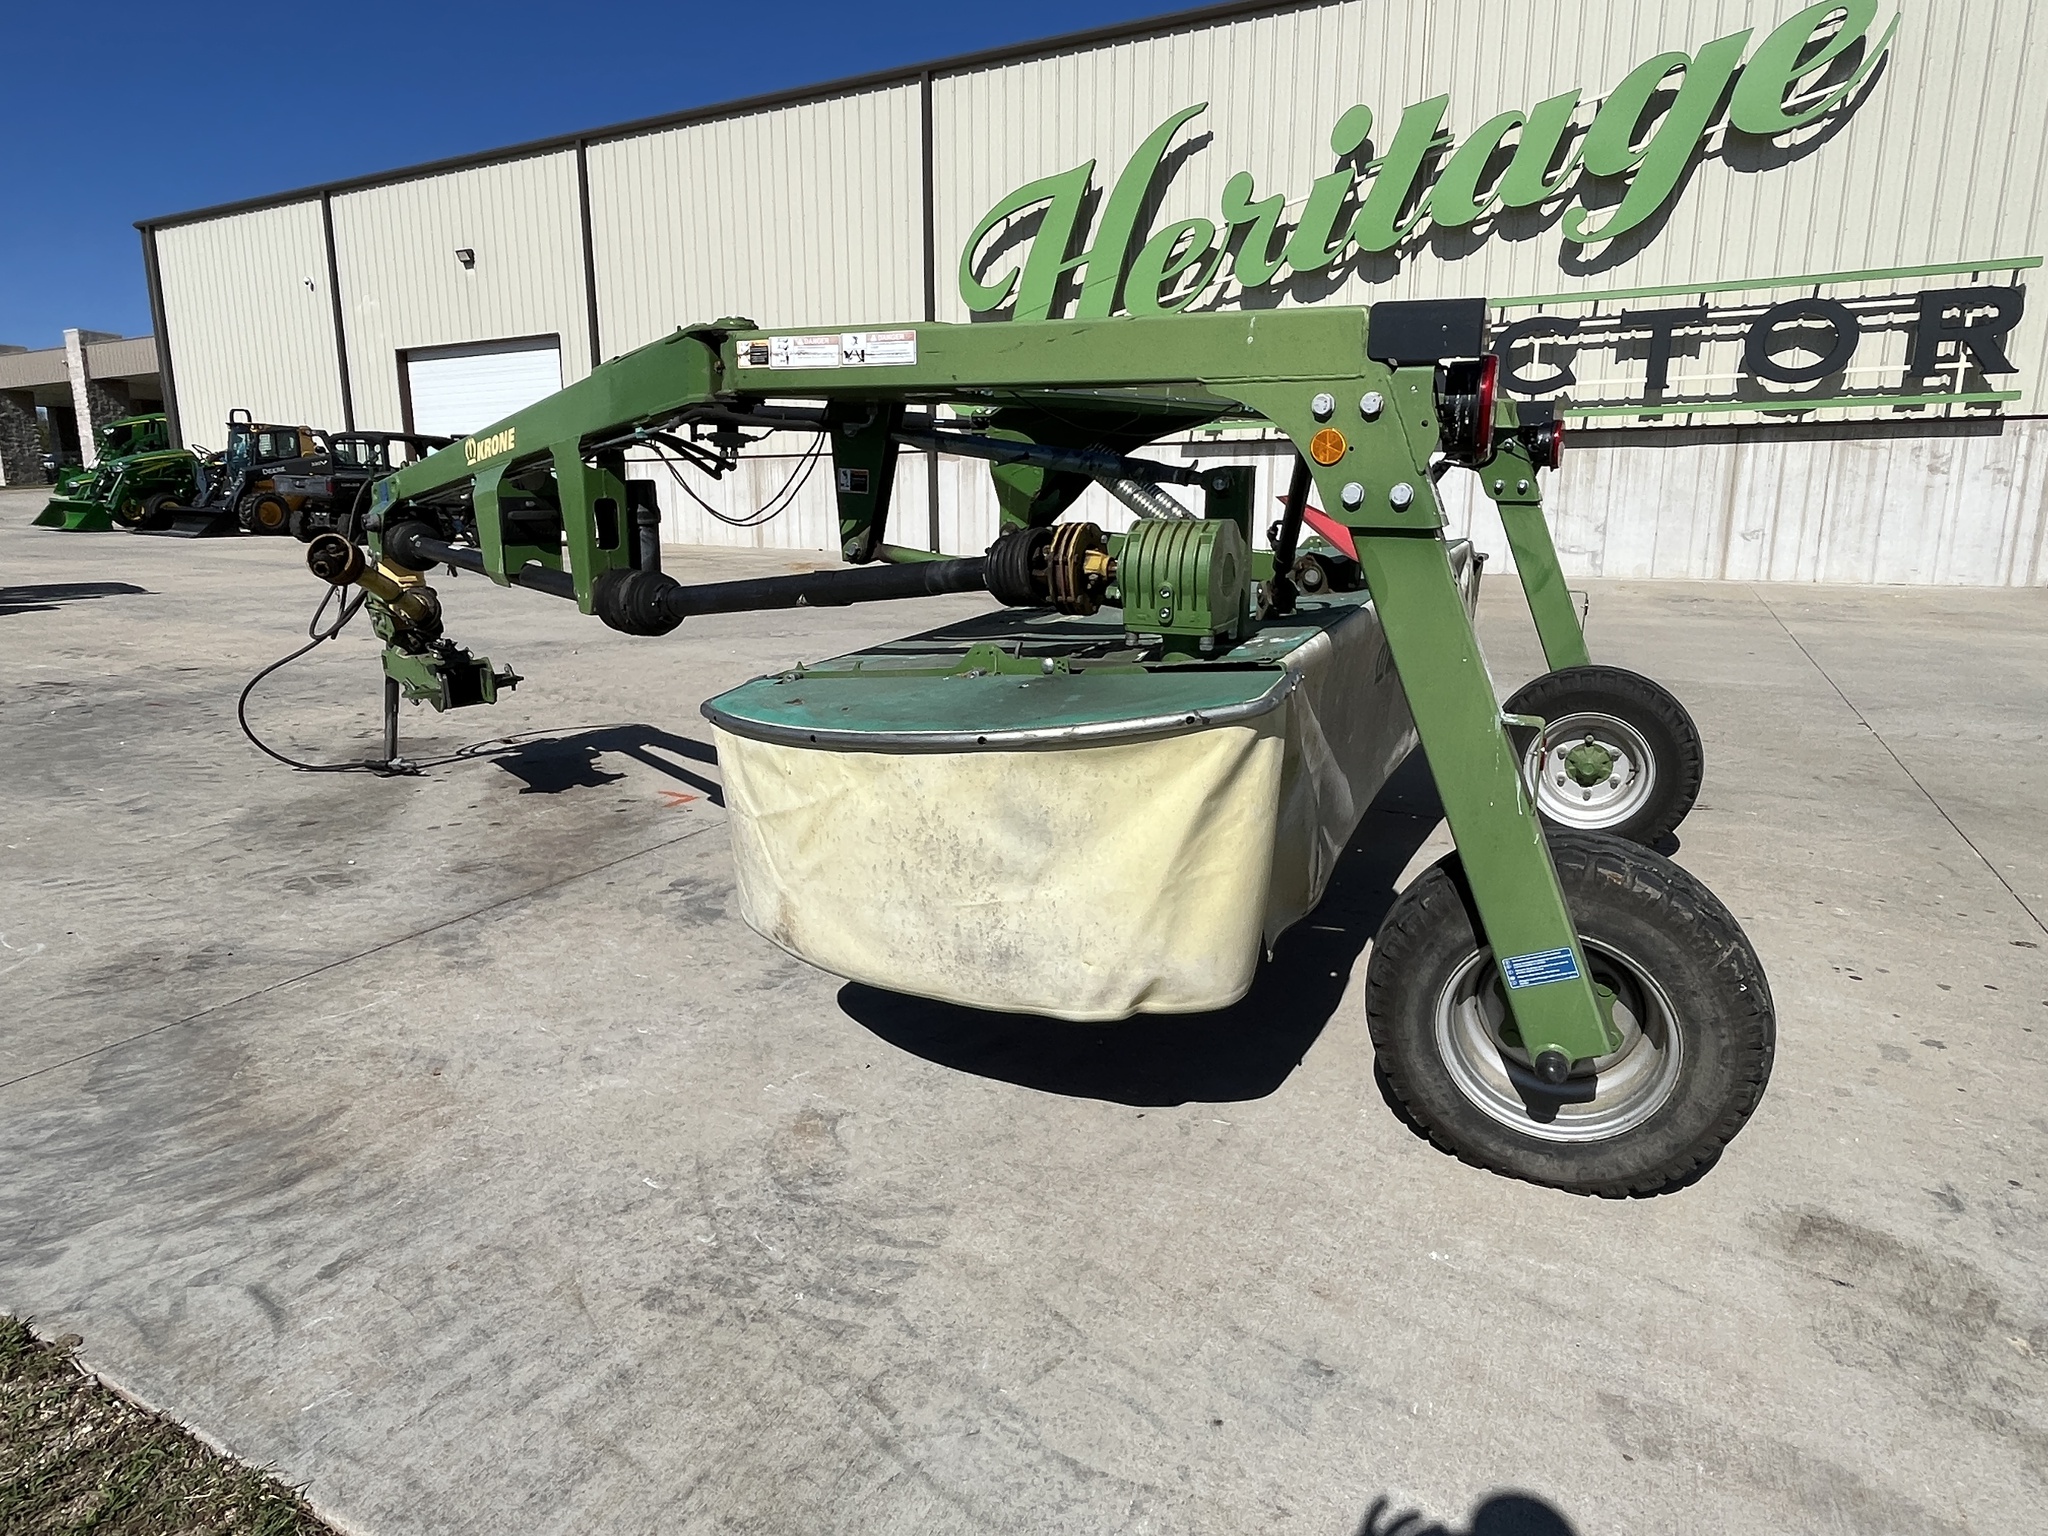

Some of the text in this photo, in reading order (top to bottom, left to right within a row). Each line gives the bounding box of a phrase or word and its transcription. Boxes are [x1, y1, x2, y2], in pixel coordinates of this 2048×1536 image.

[958, 0, 1901, 321] Heritage
[803, 337, 830, 345] DANGER
[1492, 285, 2021, 395] CTOR
[476, 427, 516, 462] KRONE
[262, 466, 287, 475] DEERE
